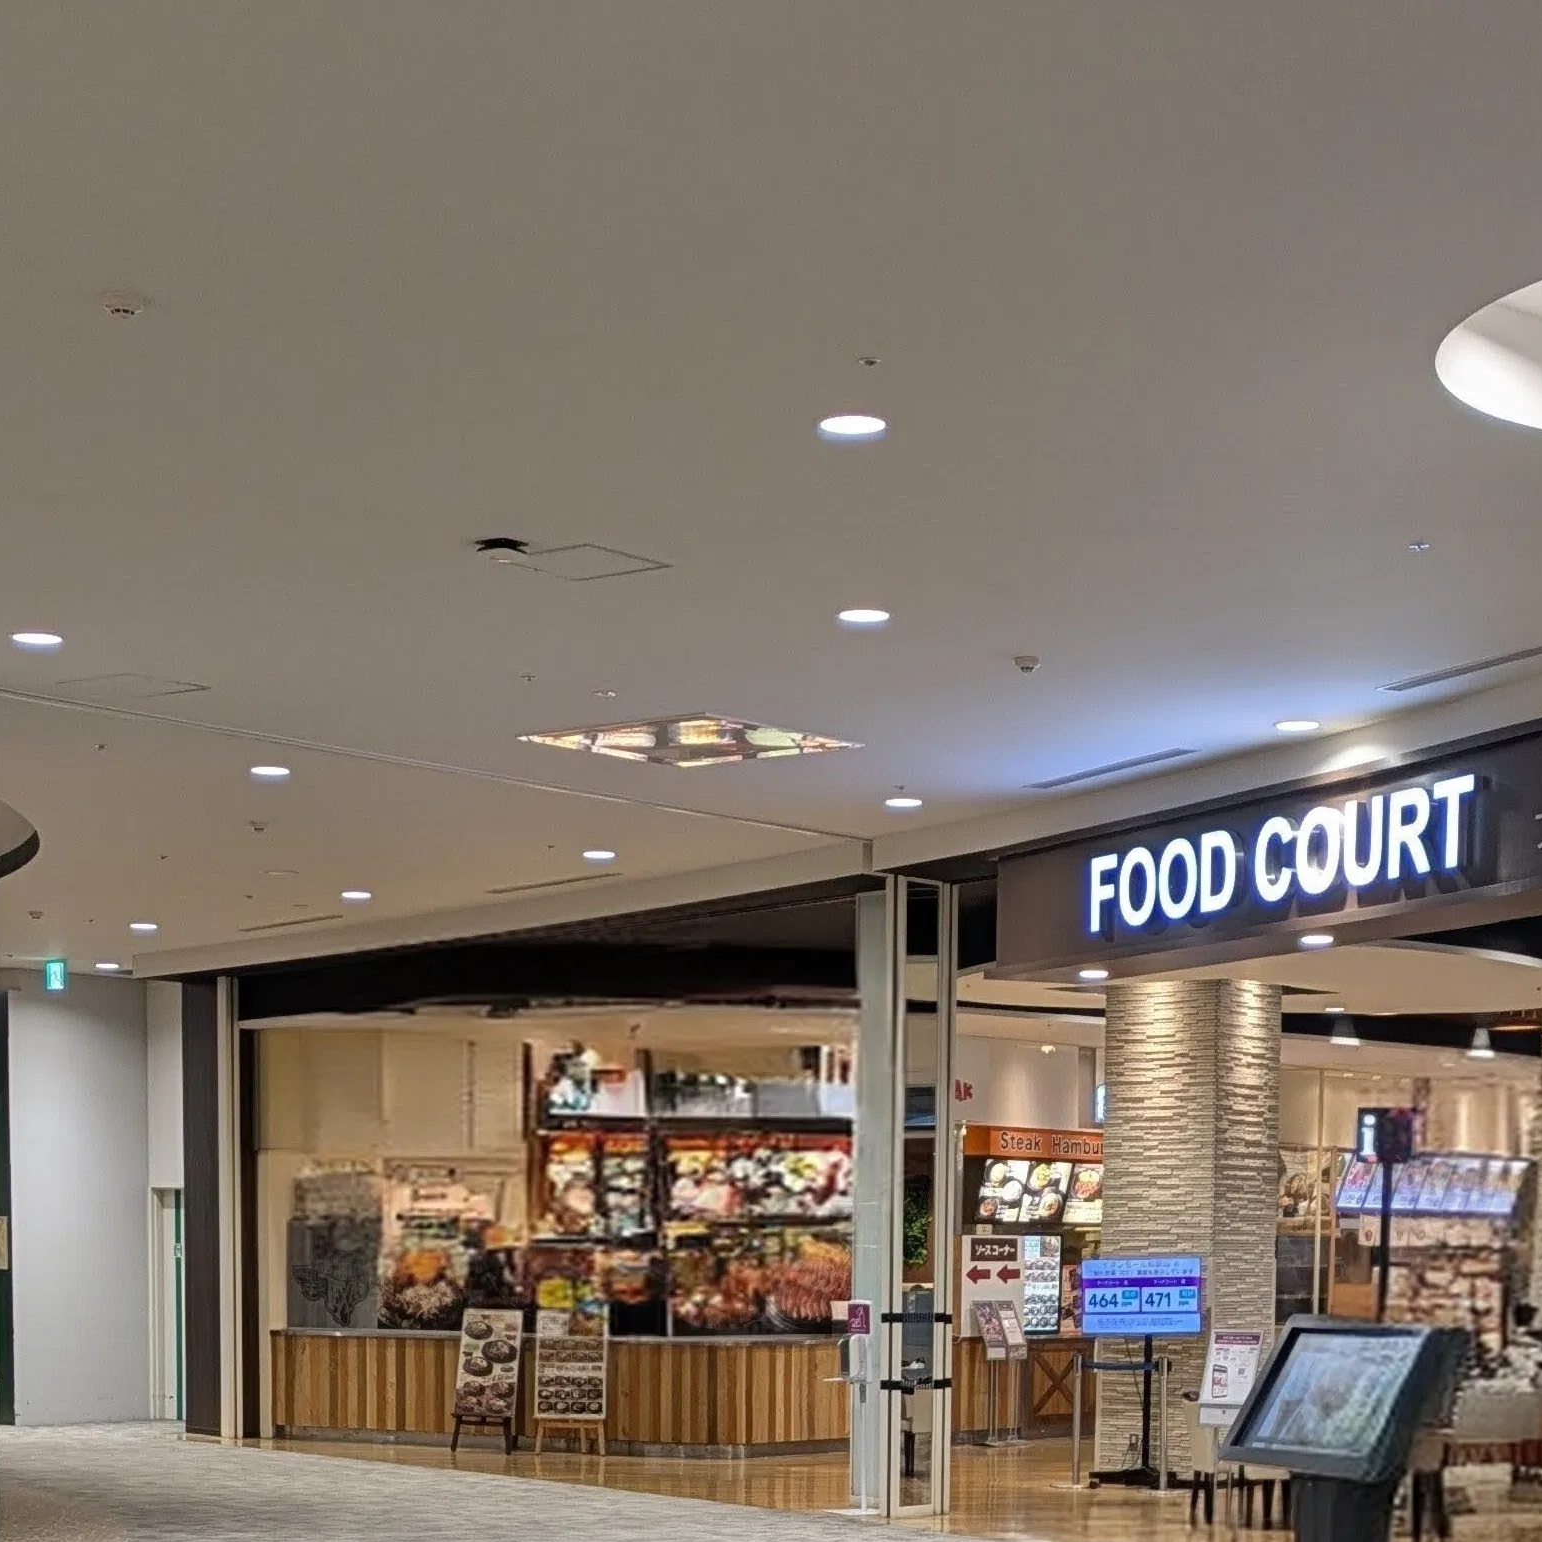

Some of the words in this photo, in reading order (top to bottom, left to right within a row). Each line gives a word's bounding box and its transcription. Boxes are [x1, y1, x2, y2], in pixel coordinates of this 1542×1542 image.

[1090, 829, 1236, 933] FOOD
[1255, 774, 1475, 902] COURT
[1000, 1131, 1042, 1151] Steak
[975, 1244, 1016, 1256] ソースコーナー
[1088, 1293, 1119, 1309] 464
[1145, 1292, 1171, 1308] 471
